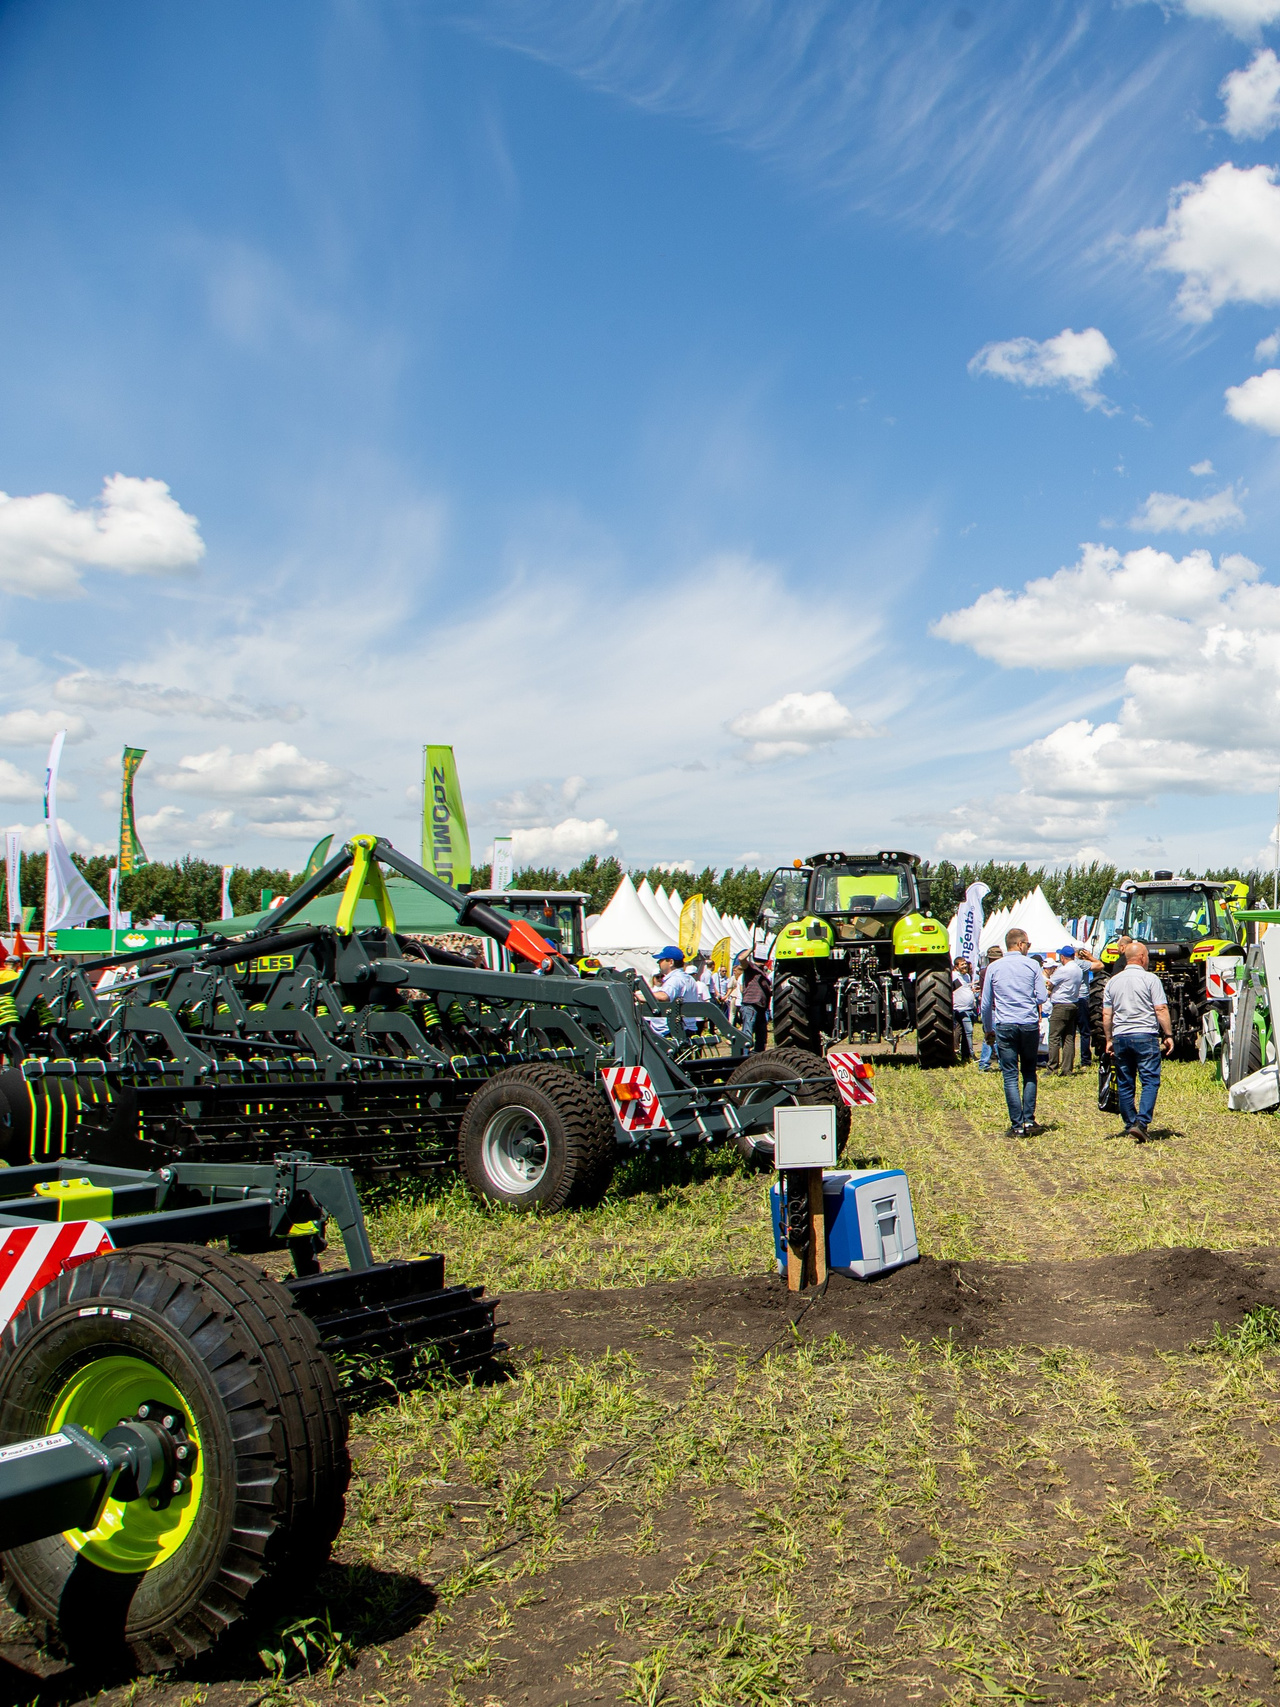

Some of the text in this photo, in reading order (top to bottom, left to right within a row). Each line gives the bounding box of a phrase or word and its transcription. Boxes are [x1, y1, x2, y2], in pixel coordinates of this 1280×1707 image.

[236, 956, 291, 971] VELES
[838, 1068, 849, 1079] 20
[46, 1438, 62, 1446] Bar
